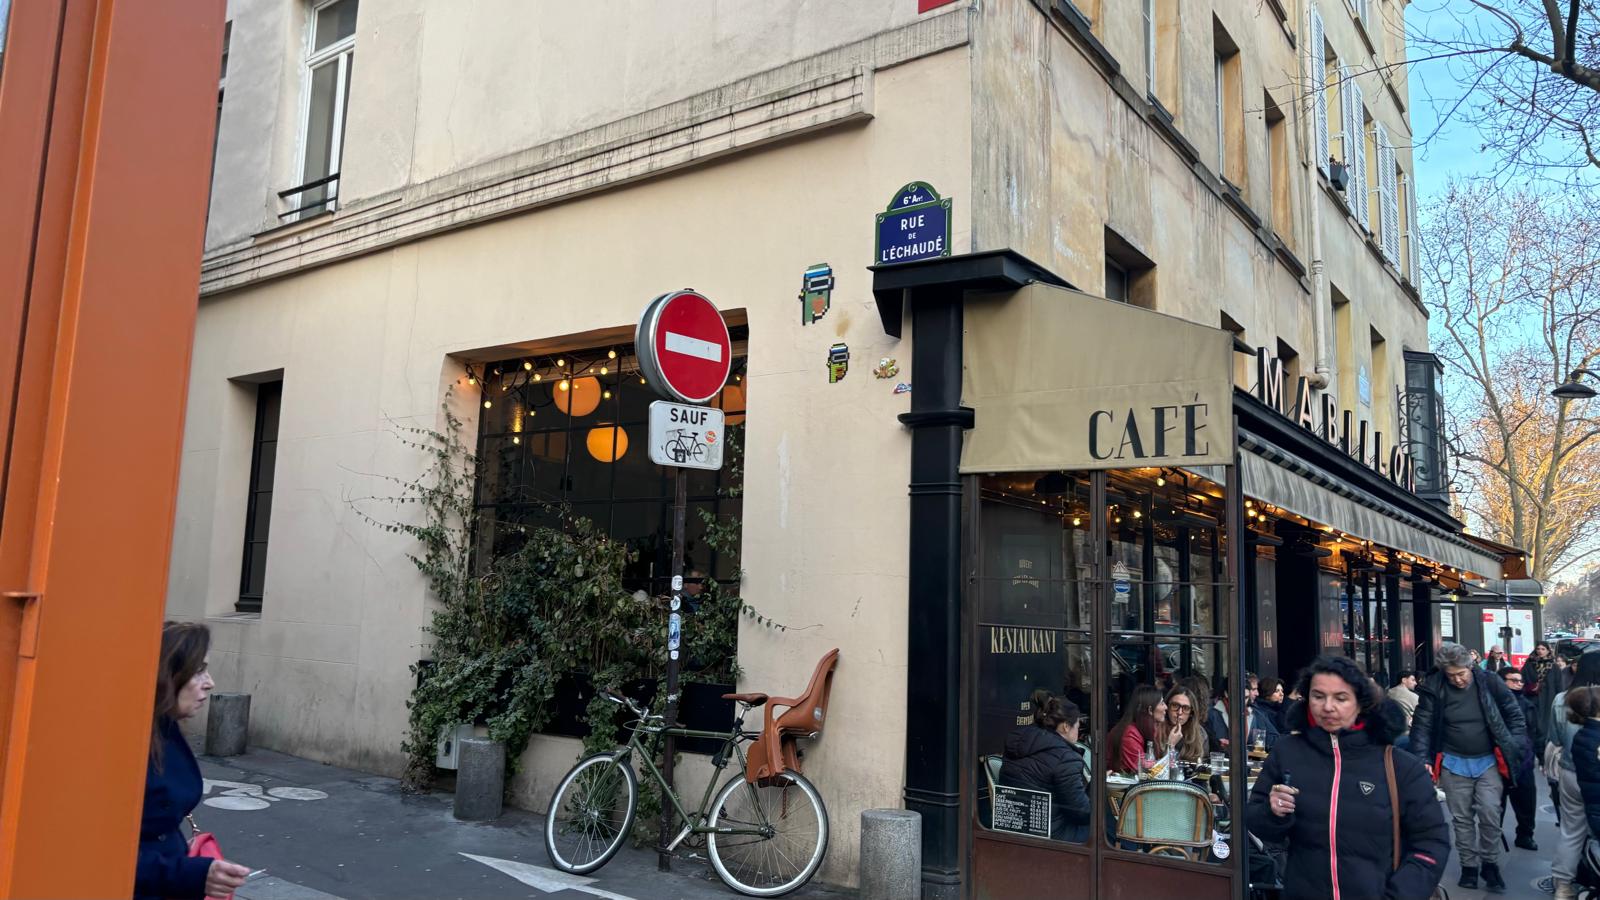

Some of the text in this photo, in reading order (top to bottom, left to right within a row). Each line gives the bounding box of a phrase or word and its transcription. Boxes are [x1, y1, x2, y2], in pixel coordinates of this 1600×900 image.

[901, 215, 925, 231] RUE
[908, 232, 917, 240] DE
[882, 235, 943, 261] L'ÉCHAUDÉ
[670, 407, 708, 426] SAUF
[1088, 392, 1209, 460] CAFÉ
[1257, 346, 1416, 494] MABILLON
[991, 626, 1056, 653] RESTAURANT
